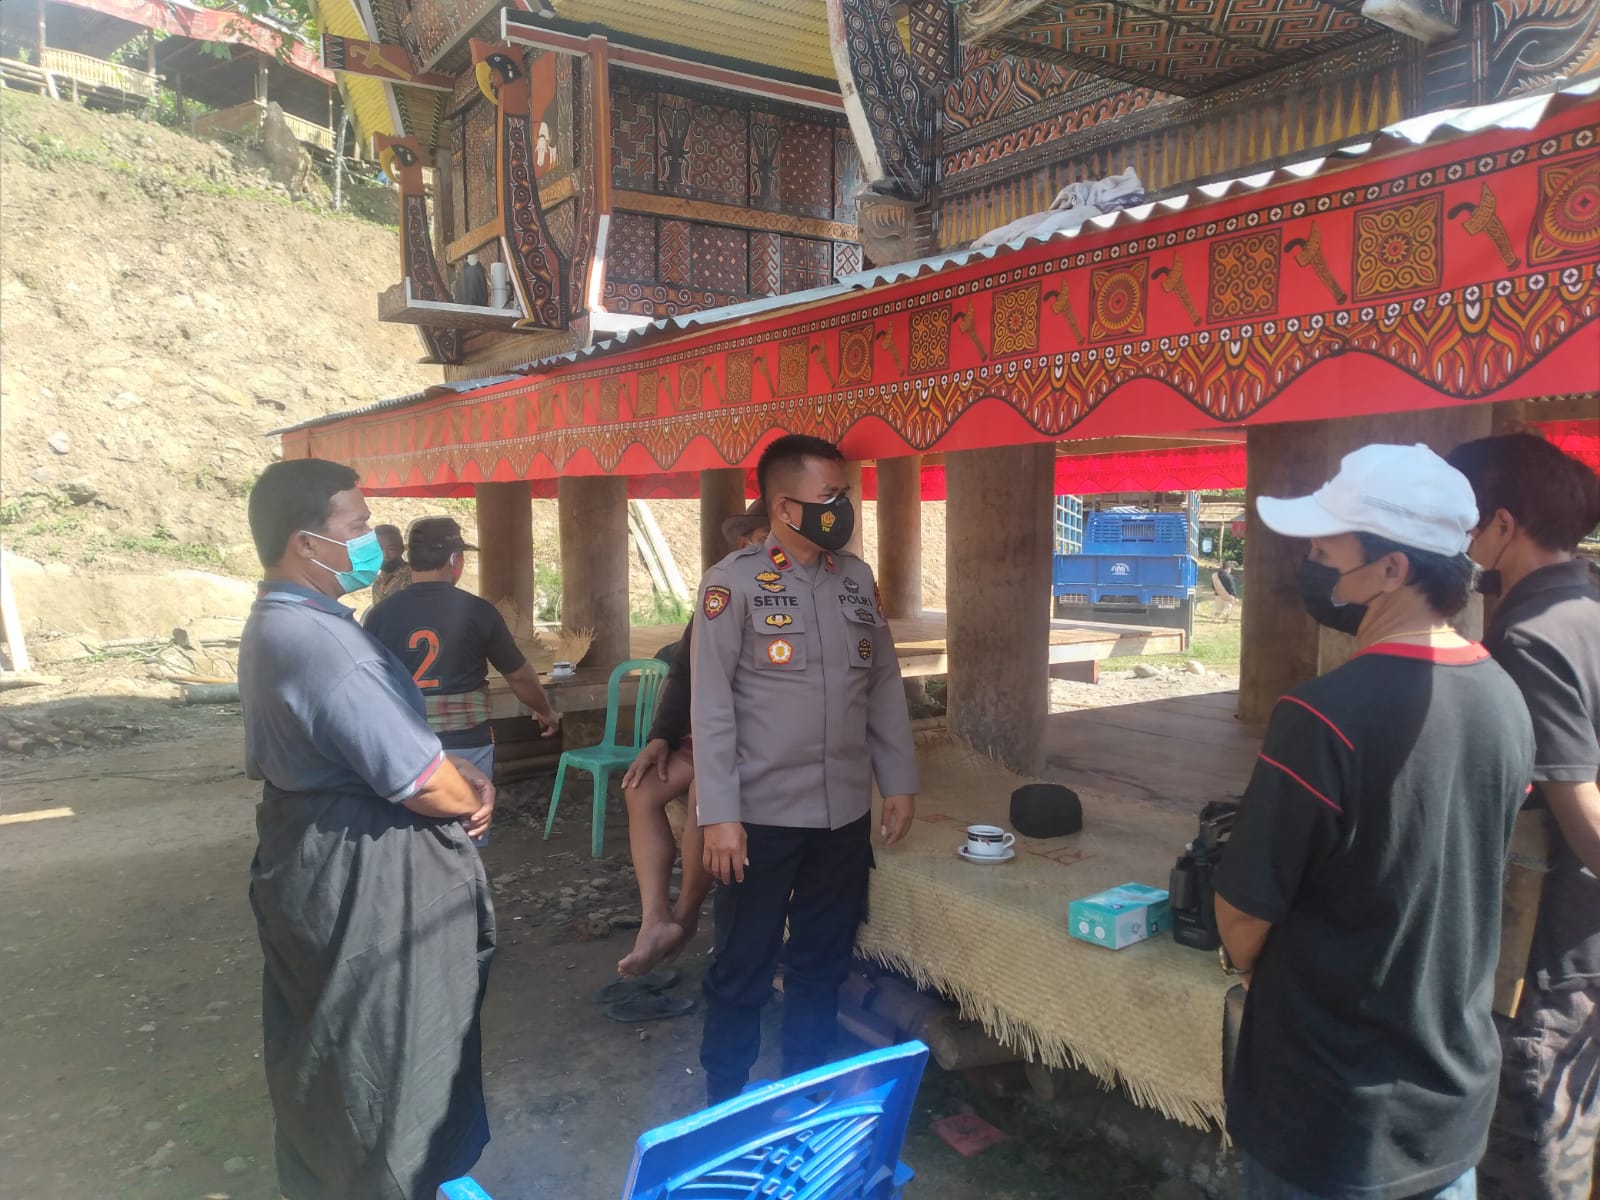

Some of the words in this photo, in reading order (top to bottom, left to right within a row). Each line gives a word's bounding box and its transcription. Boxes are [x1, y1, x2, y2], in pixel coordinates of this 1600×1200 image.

[753, 595, 799, 607] SETTE
[838, 594, 873, 607] POLRI
[407, 628, 441, 689] 2
